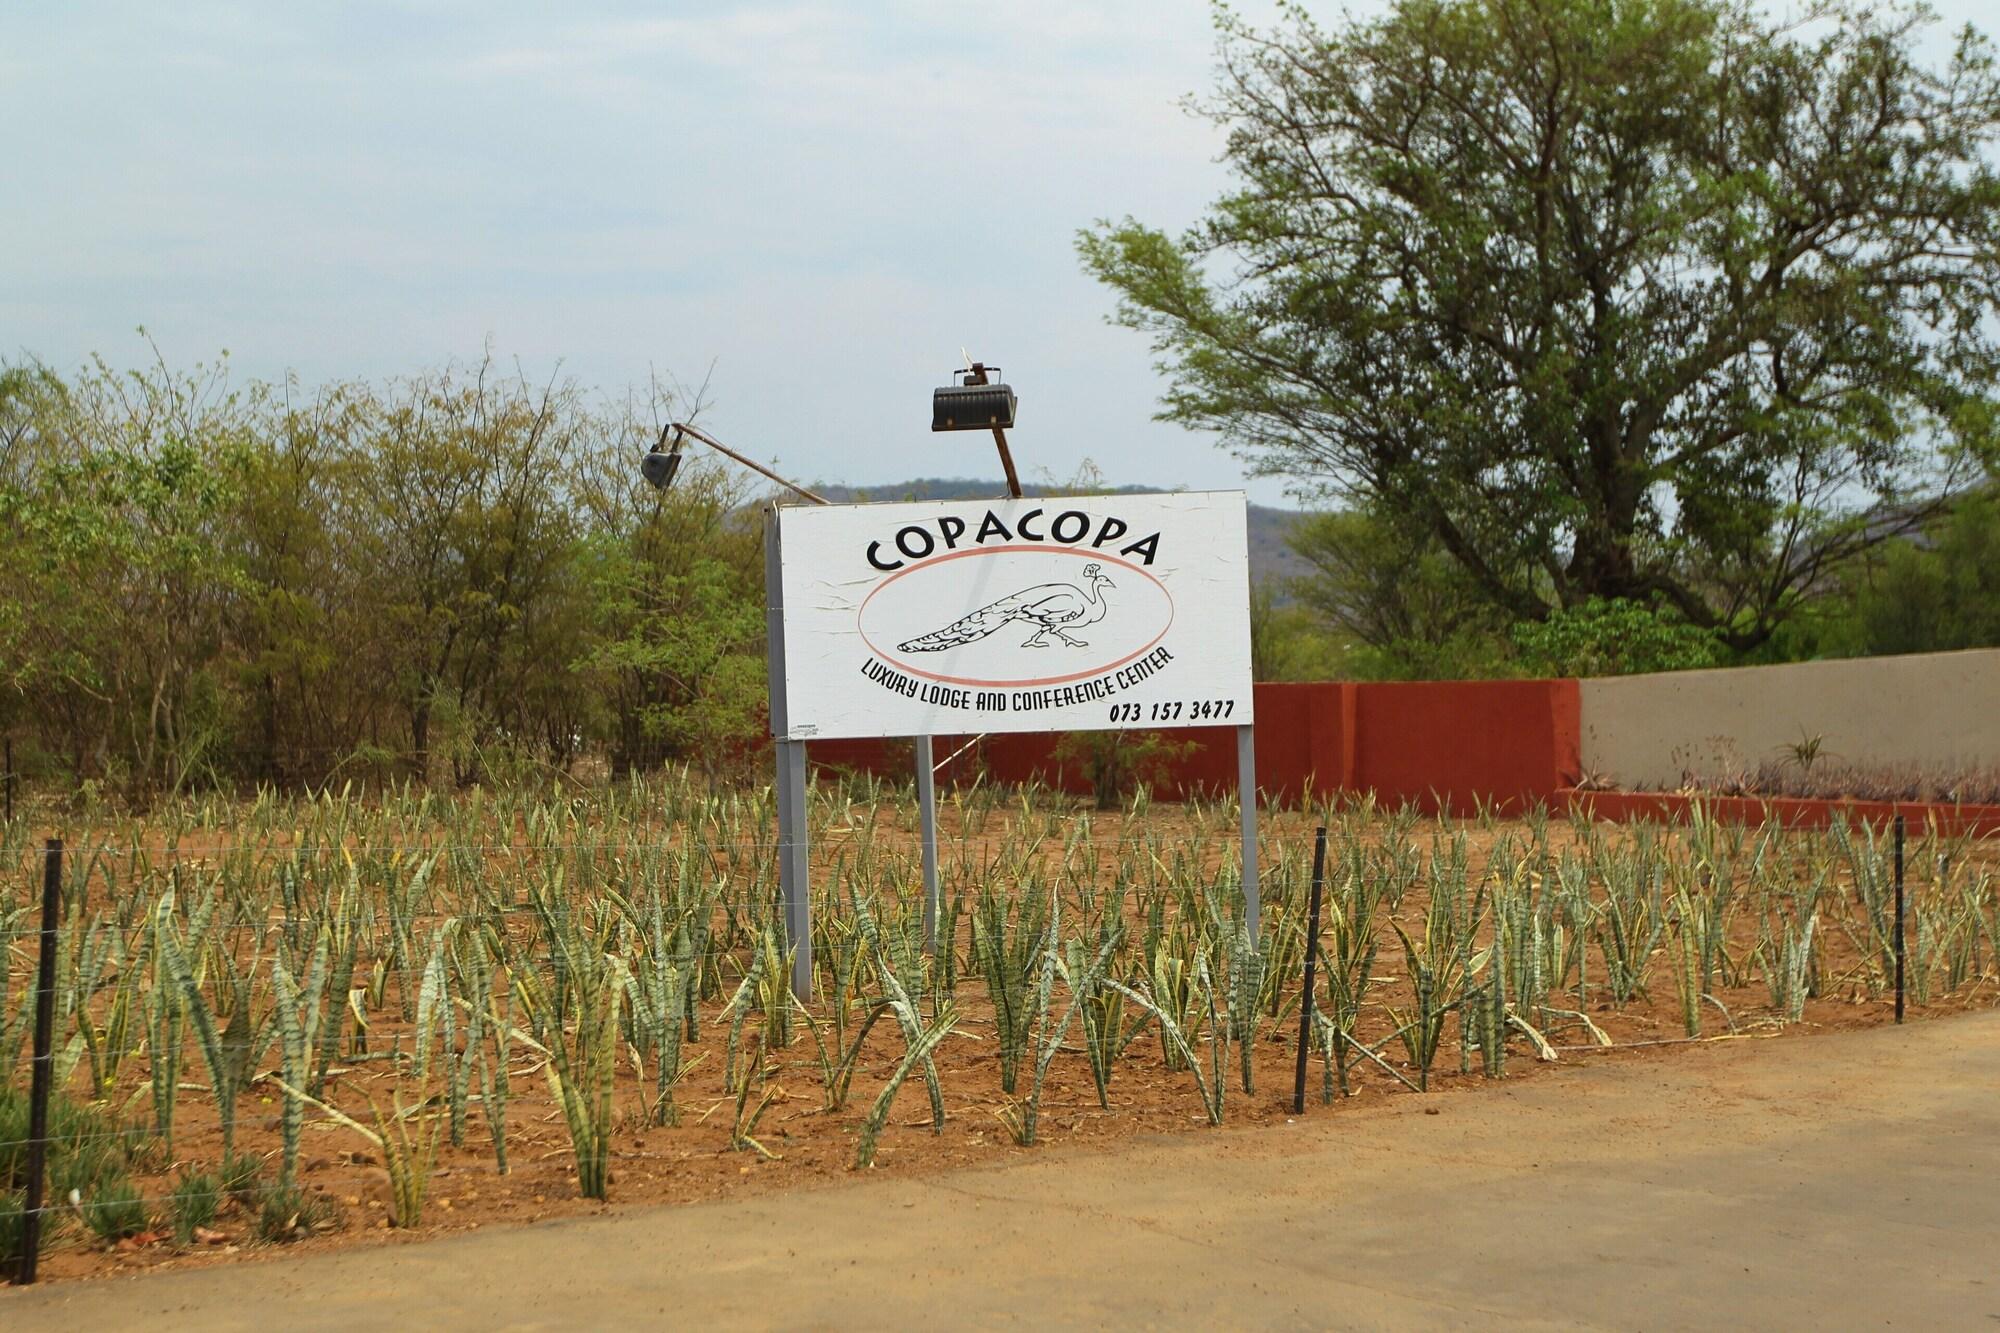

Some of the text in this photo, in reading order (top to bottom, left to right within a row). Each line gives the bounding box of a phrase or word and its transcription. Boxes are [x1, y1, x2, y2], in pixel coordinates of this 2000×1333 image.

[866, 509, 1161, 571] COPACOPA
[861, 646, 1174, 712] LUXURY LODGE AND CONFERENCE CENTER
[1109, 700, 1235, 723] 073 157 3477
